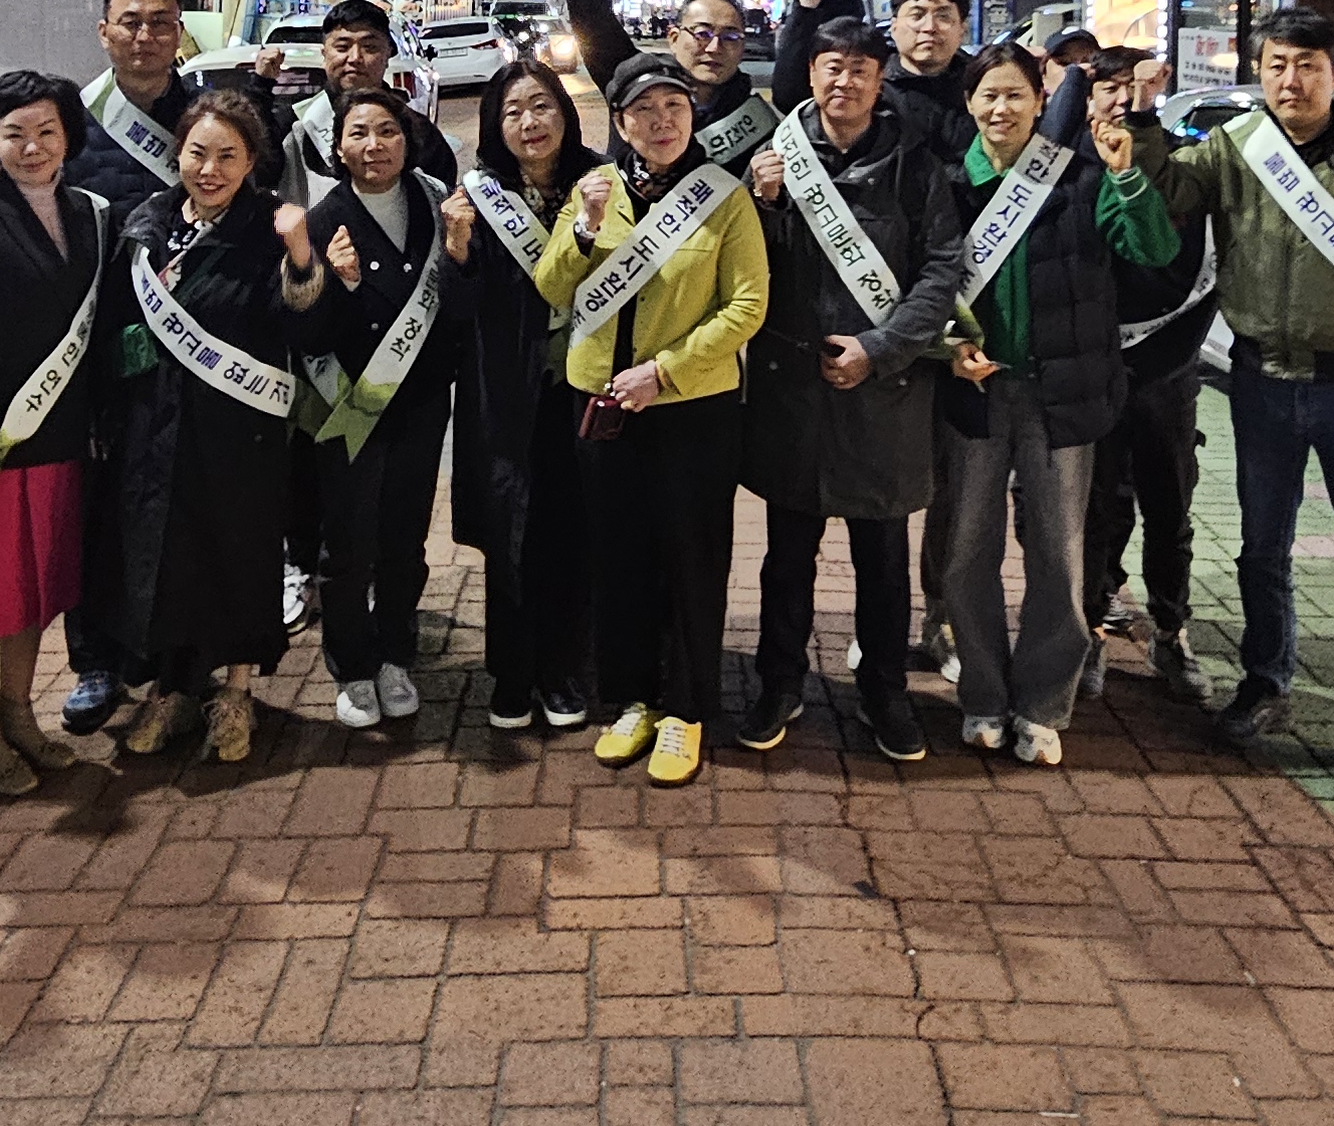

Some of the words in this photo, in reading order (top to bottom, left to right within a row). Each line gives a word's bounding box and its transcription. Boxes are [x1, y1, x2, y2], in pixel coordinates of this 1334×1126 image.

[1021, 138, 1060, 186] 적한
[1262, 152, 1300, 194] 불법
[654, 178, 717, 242] 쾌적한
[970, 183, 1035, 266] 도시환경
[584, 240, 662, 314] 도시환경
[856, 269, 896, 314] 정착
[162, 311, 224, 371] 광고물
[390, 317, 425, 363] 정착
[25, 367, 62, 414] 연수
